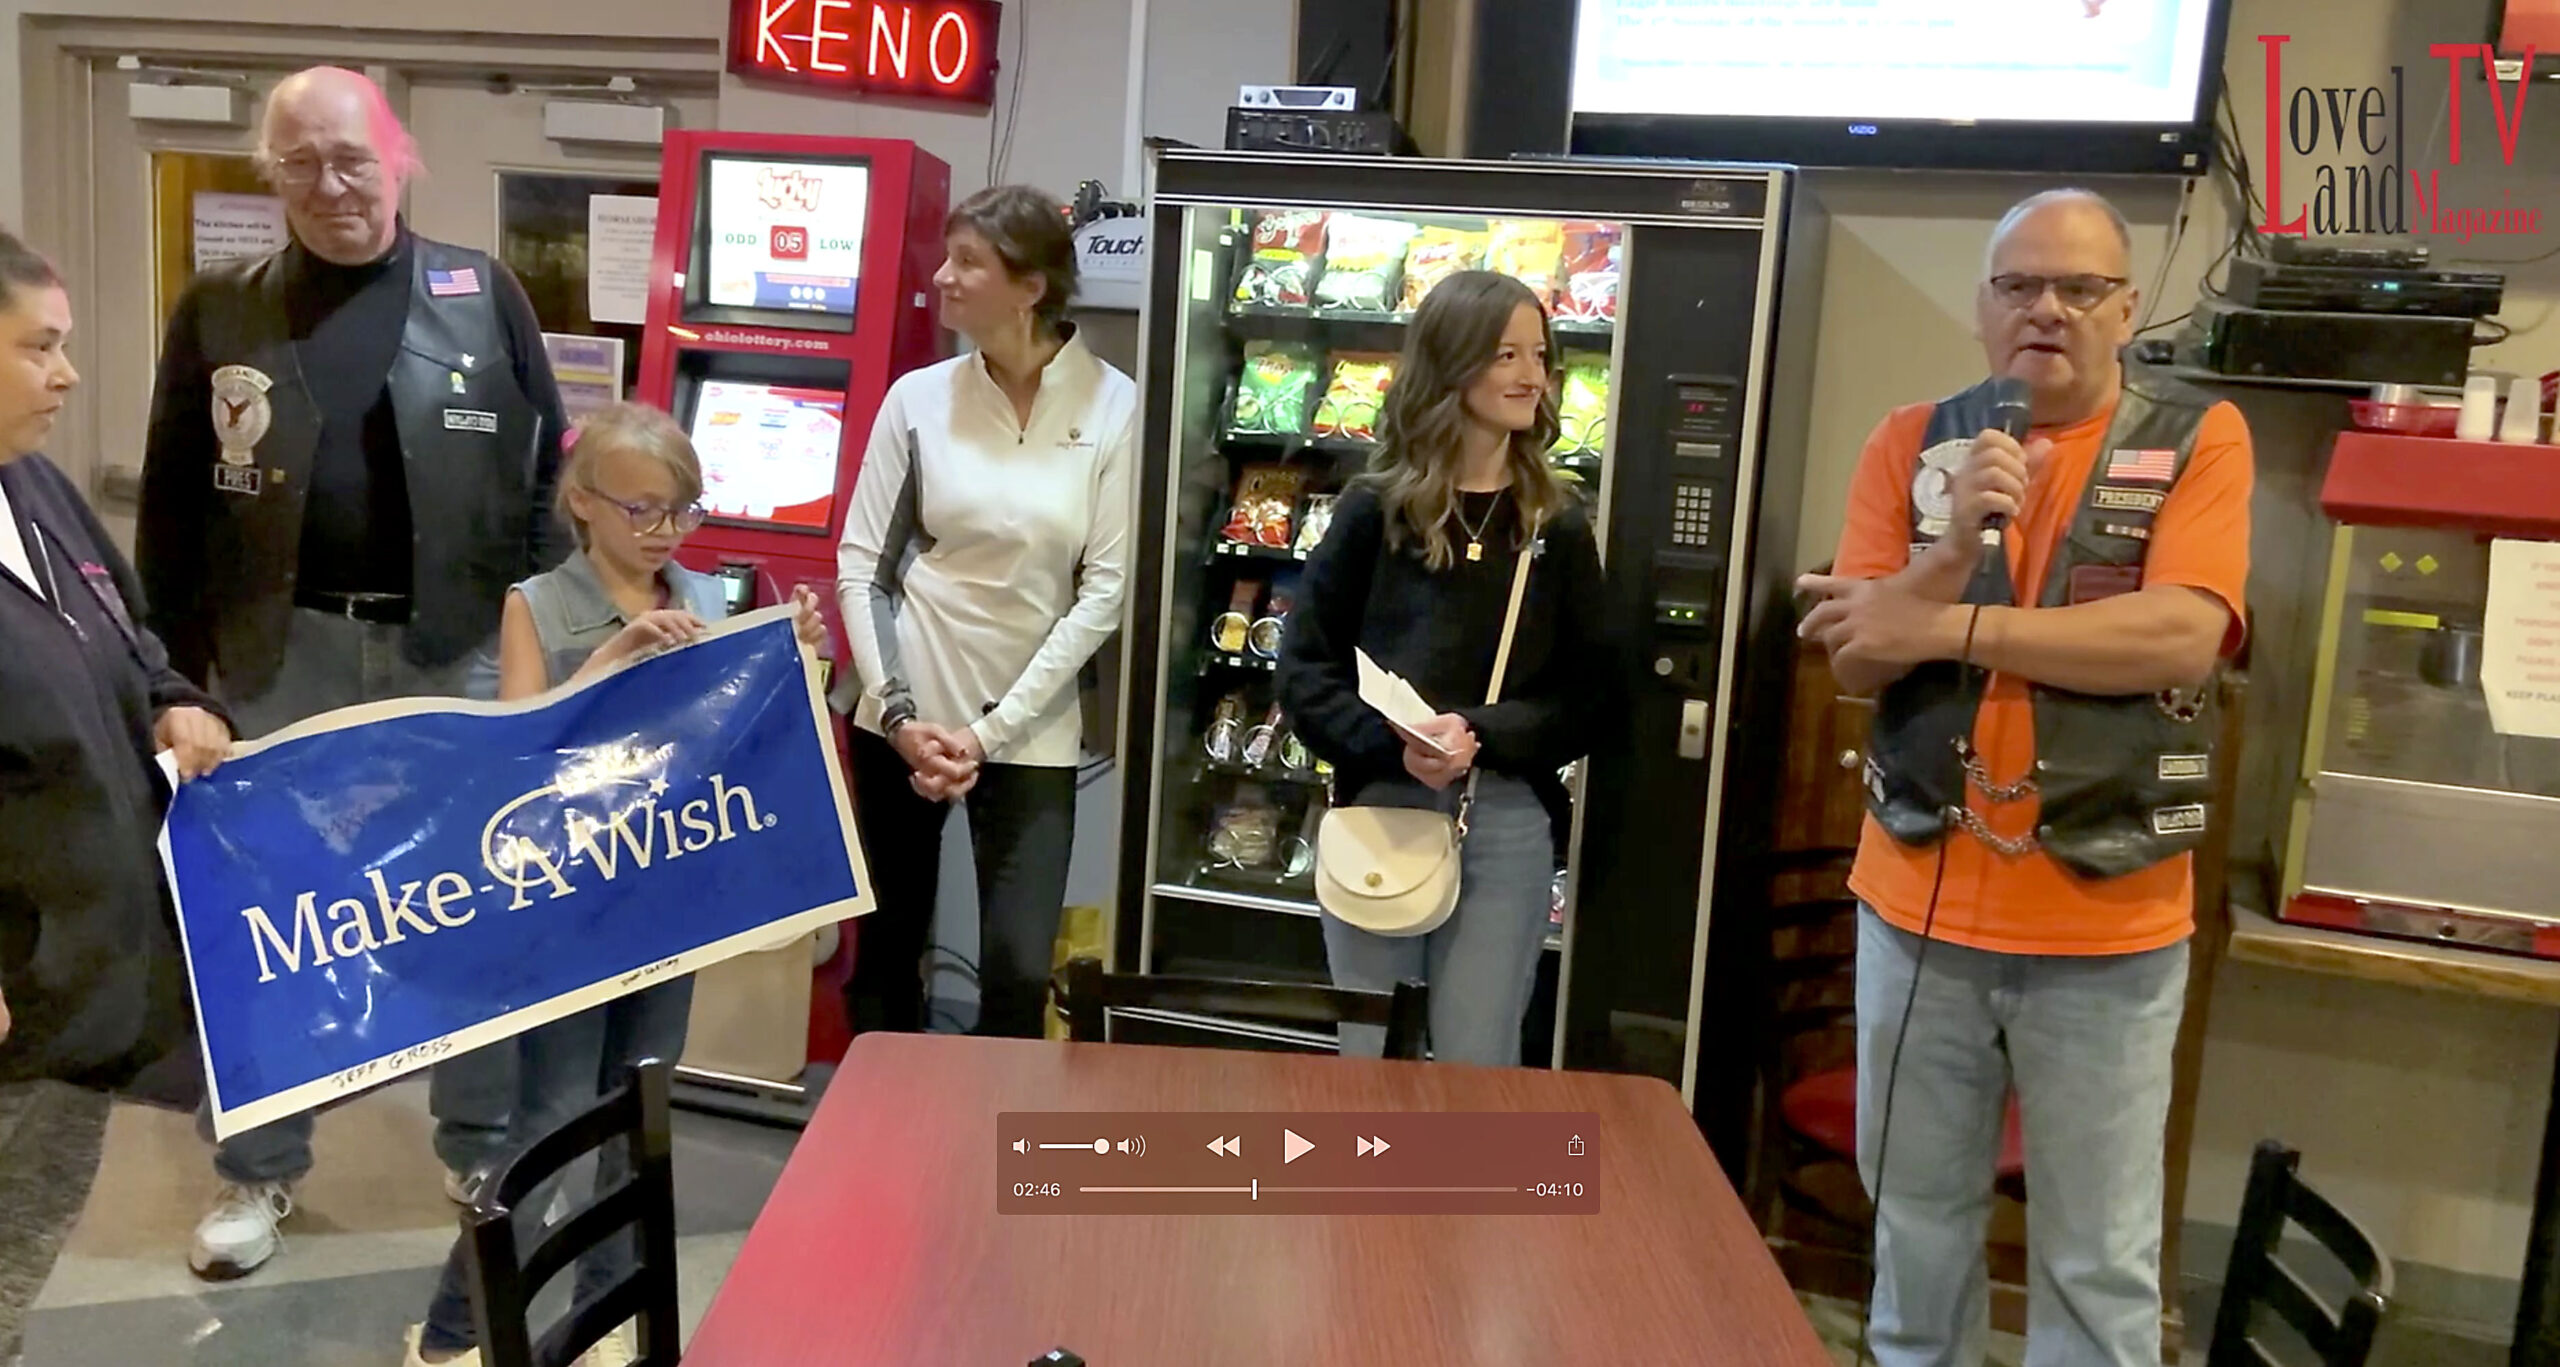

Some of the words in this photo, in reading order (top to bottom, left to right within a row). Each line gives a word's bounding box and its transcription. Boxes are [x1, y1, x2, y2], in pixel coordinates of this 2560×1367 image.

[756, 0, 968, 84] KENO
[757, 167, 823, 212] Lucky
[726, 233, 757, 245] ODD
[776, 233, 802, 253] 05
[820, 238, 854, 251] LOW
[704, 330, 829, 350] ohiolottery.com
[388, 1035, 453, 1070] GROSS
